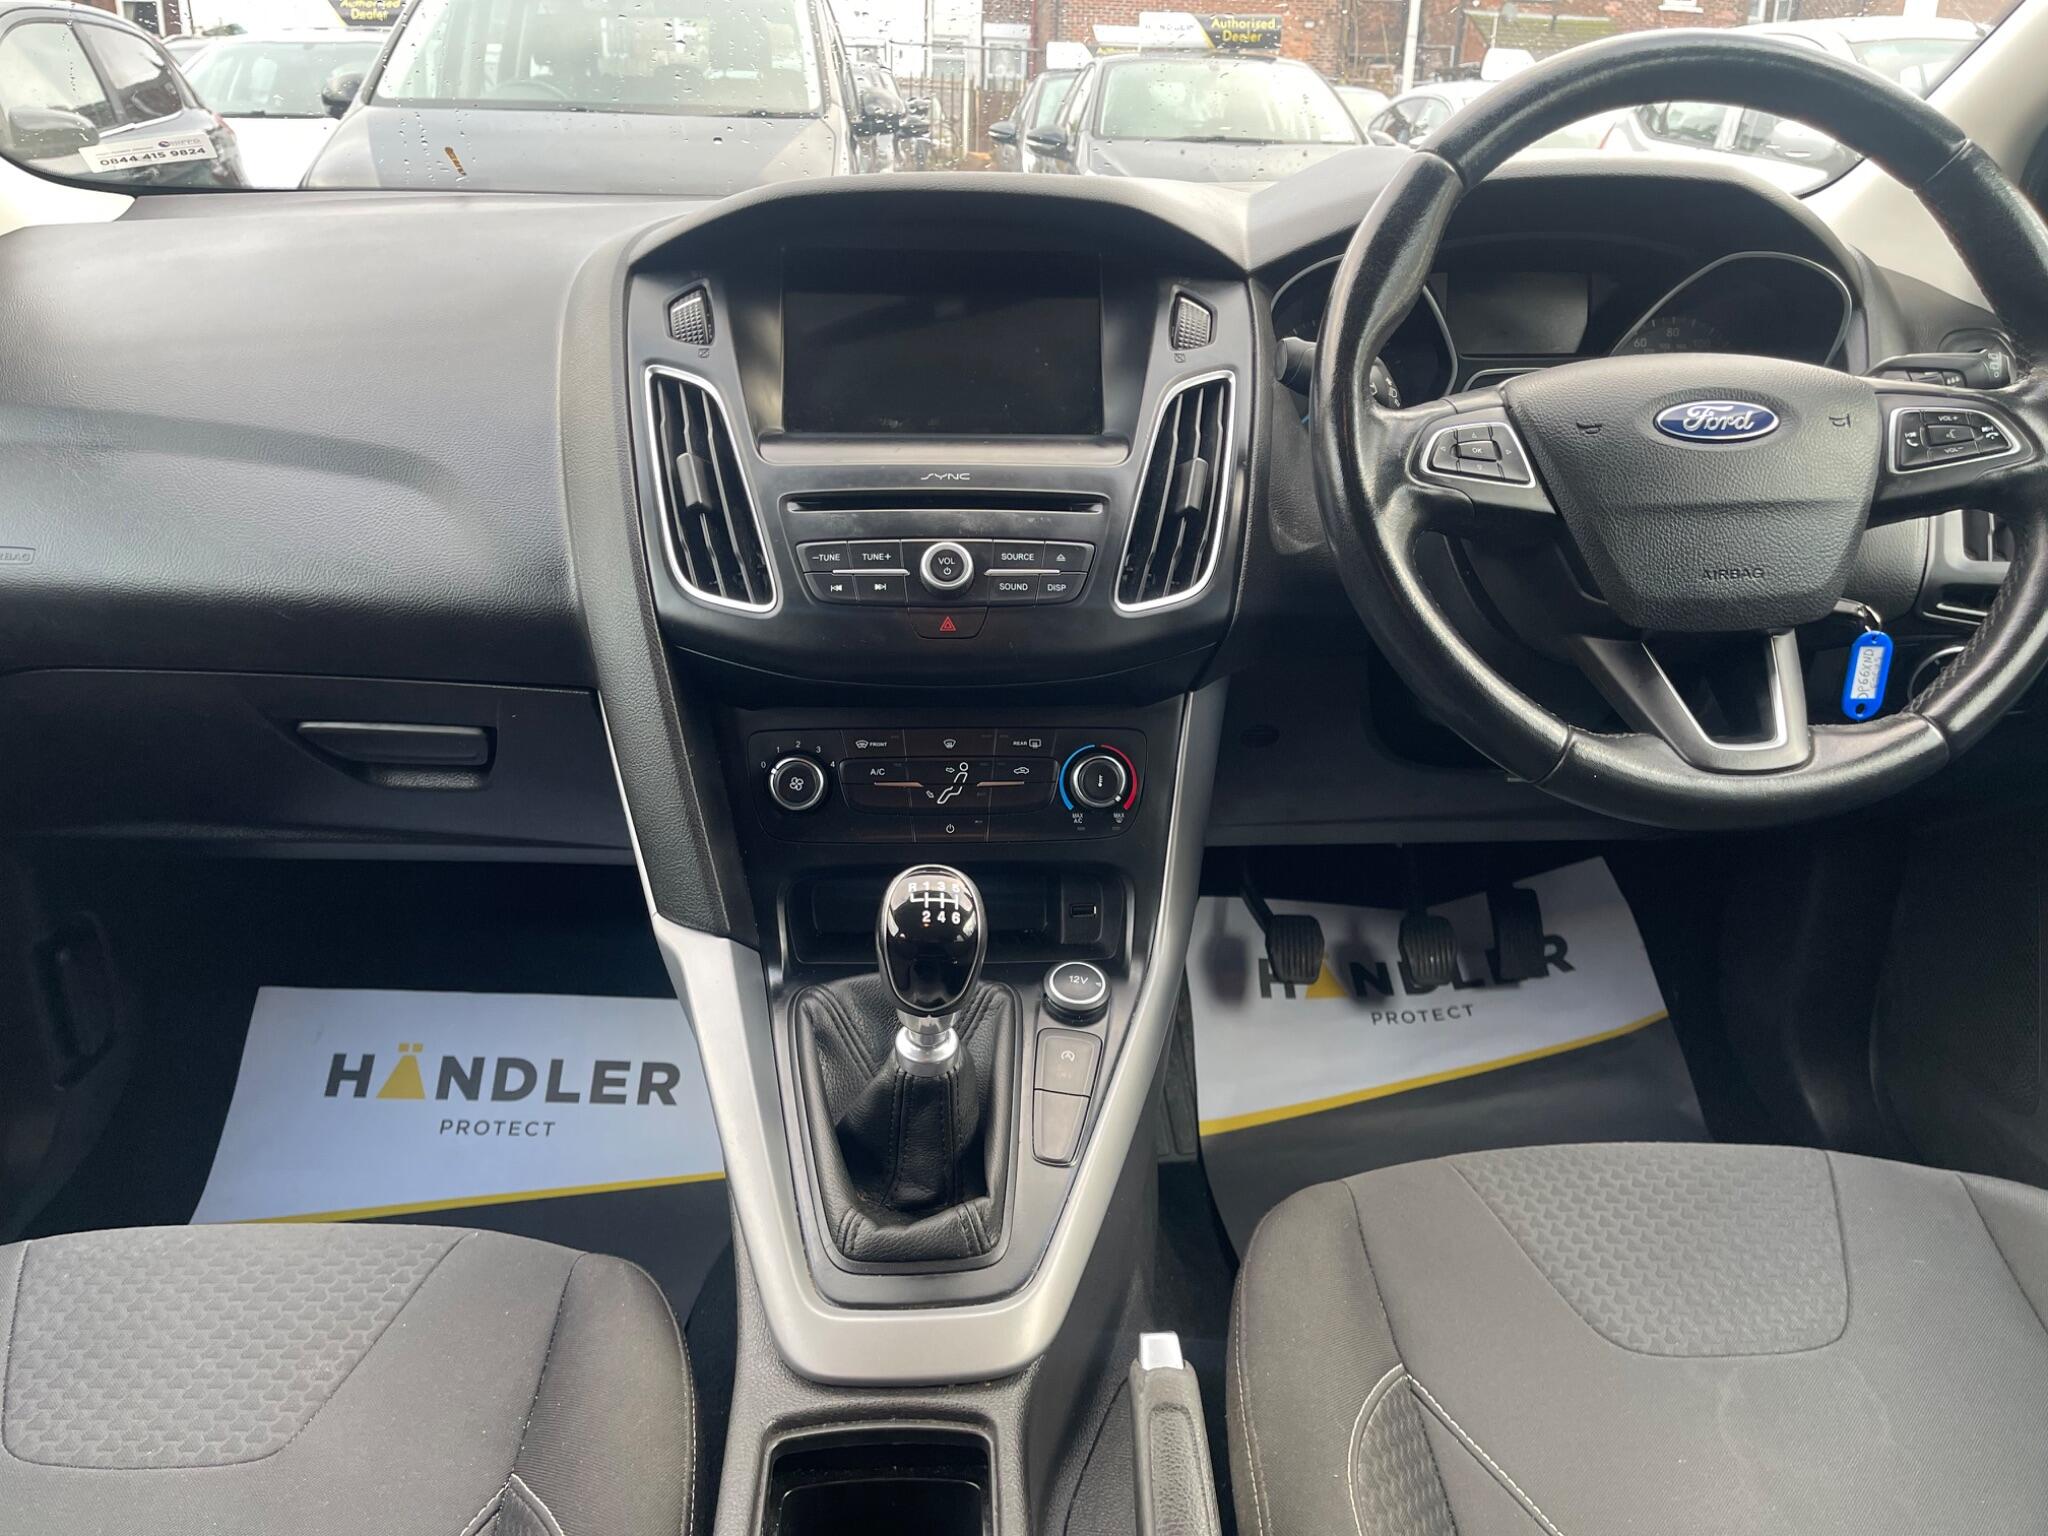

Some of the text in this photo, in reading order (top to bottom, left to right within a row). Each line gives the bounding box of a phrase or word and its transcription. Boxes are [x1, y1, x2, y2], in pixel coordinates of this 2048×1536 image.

[1211, 16, 1276, 29] Authorised
[100, 155, 138, 166] 0844
[143, 151, 166, 160] 415
[170, 147, 206, 157] 9824
[1666, 328, 1680, 337] 80
[1633, 338, 1647, 348] 60
[1683, 405, 1755, 432] Ford
[920, 472, 970, 480] SYNC
[938, 557, 955, 565] VOL
[1001, 553, 1034, 561] SOURCE
[1702, 567, 1764, 581] AIRBAG
[1000, 583, 1028, 591] SOUND
[760, 761, 766, 769] 0
[870, 768, 885, 776] A/C
[908, 881, 960, 893] R 1 3 5
[922, 910, 960, 924] 2 4 6
[1069, 975, 1088, 985] 12V
[1371, 1003, 1474, 1026] PROTECT
[324, 1043, 681, 1105] HÄNDLER
[439, 1119, 556, 1138] PROTECT
